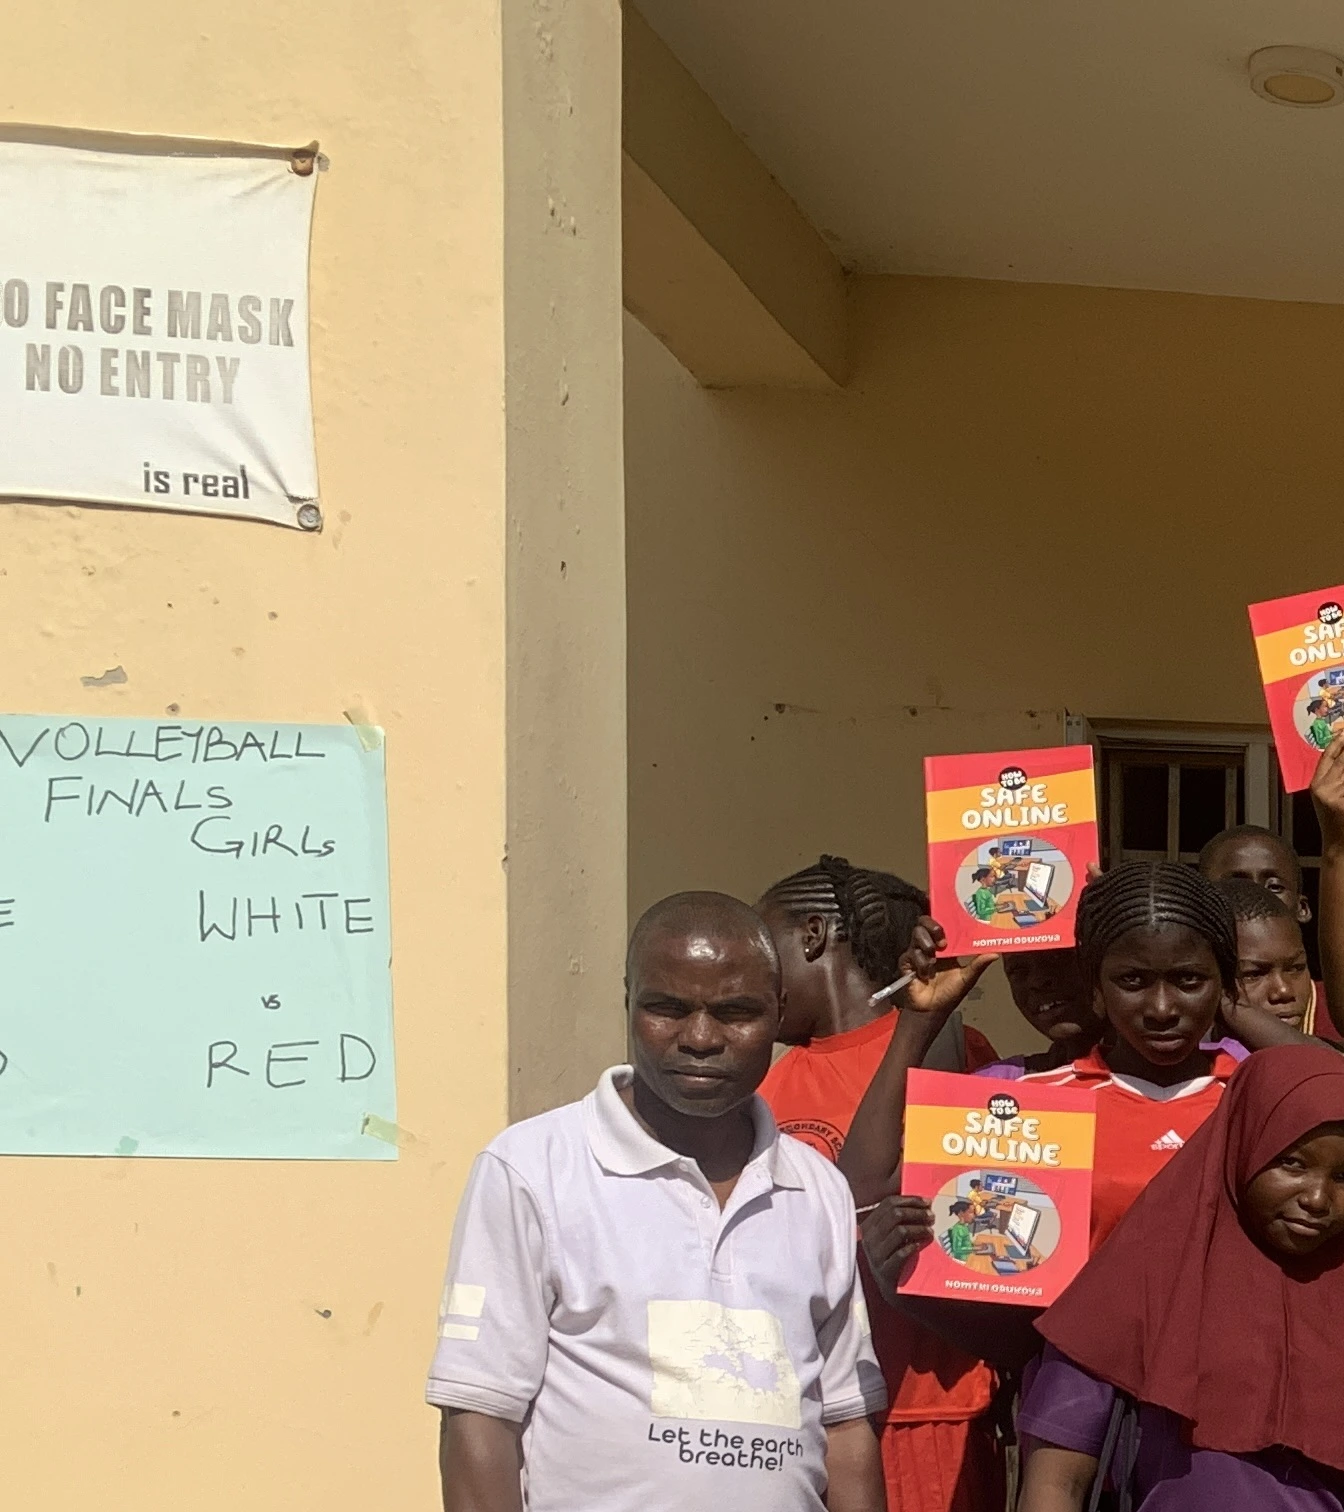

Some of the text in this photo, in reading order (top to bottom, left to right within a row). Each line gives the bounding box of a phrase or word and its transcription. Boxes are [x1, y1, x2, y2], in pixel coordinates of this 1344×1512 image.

[4, 278, 295, 347] O FACE MASK
[25, 343, 240, 404] NO ENTRY
[143, 461, 250, 499] is real
[0, 721, 326, 767] VOLLEYBALL
[1001, 770, 1022, 781] HOW
[1001, 777, 1027, 787] TO BE
[45, 776, 233, 822] FINALS
[980, 783, 1048, 808] SAFE
[961, 803, 1069, 830] ONLINE
[199, 890, 374, 942] WHITE
[206, 1033, 377, 1088] RED
[990, 1107, 1019, 1116] TO BE
[991, 1099, 1015, 1108] HOW
[964, 1111, 1041, 1141] SAFE
[942, 1133, 1062, 1168] ONLINE
[648, 1423, 804, 1457] Let the earth
[679, 1444, 783, 1472] breathe!
